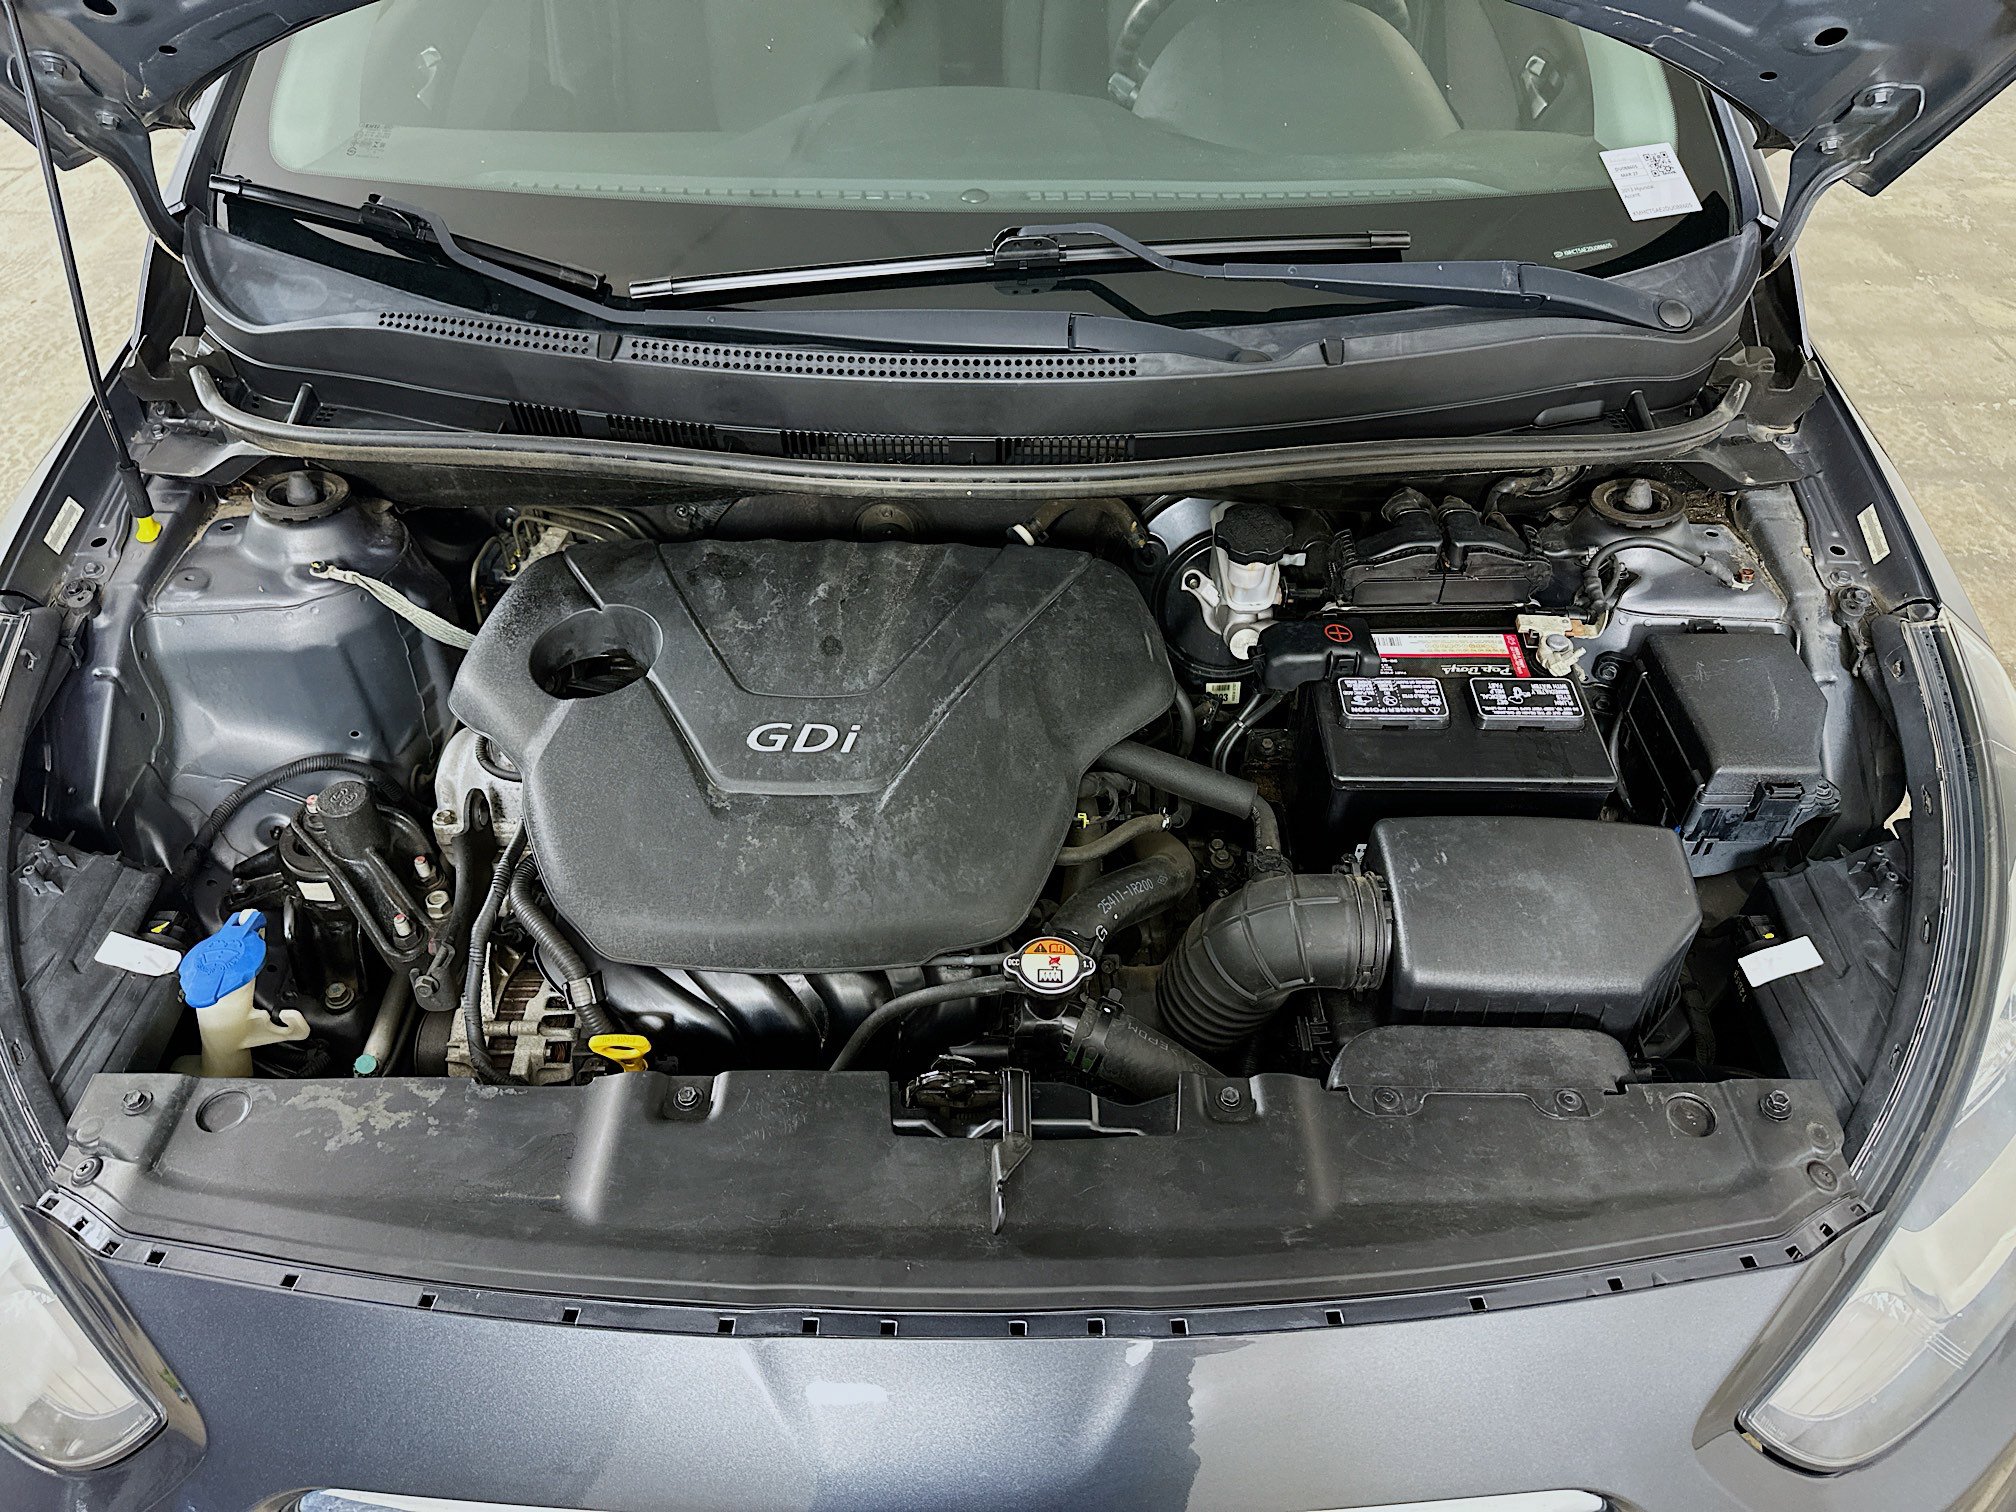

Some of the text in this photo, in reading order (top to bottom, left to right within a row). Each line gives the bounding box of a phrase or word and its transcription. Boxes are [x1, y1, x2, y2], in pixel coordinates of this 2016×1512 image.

[746, 722, 861, 753] GDi
[1097, 878, 1154, 915] 25411-1R200
[1082, 960, 1093, 968] 1.1
